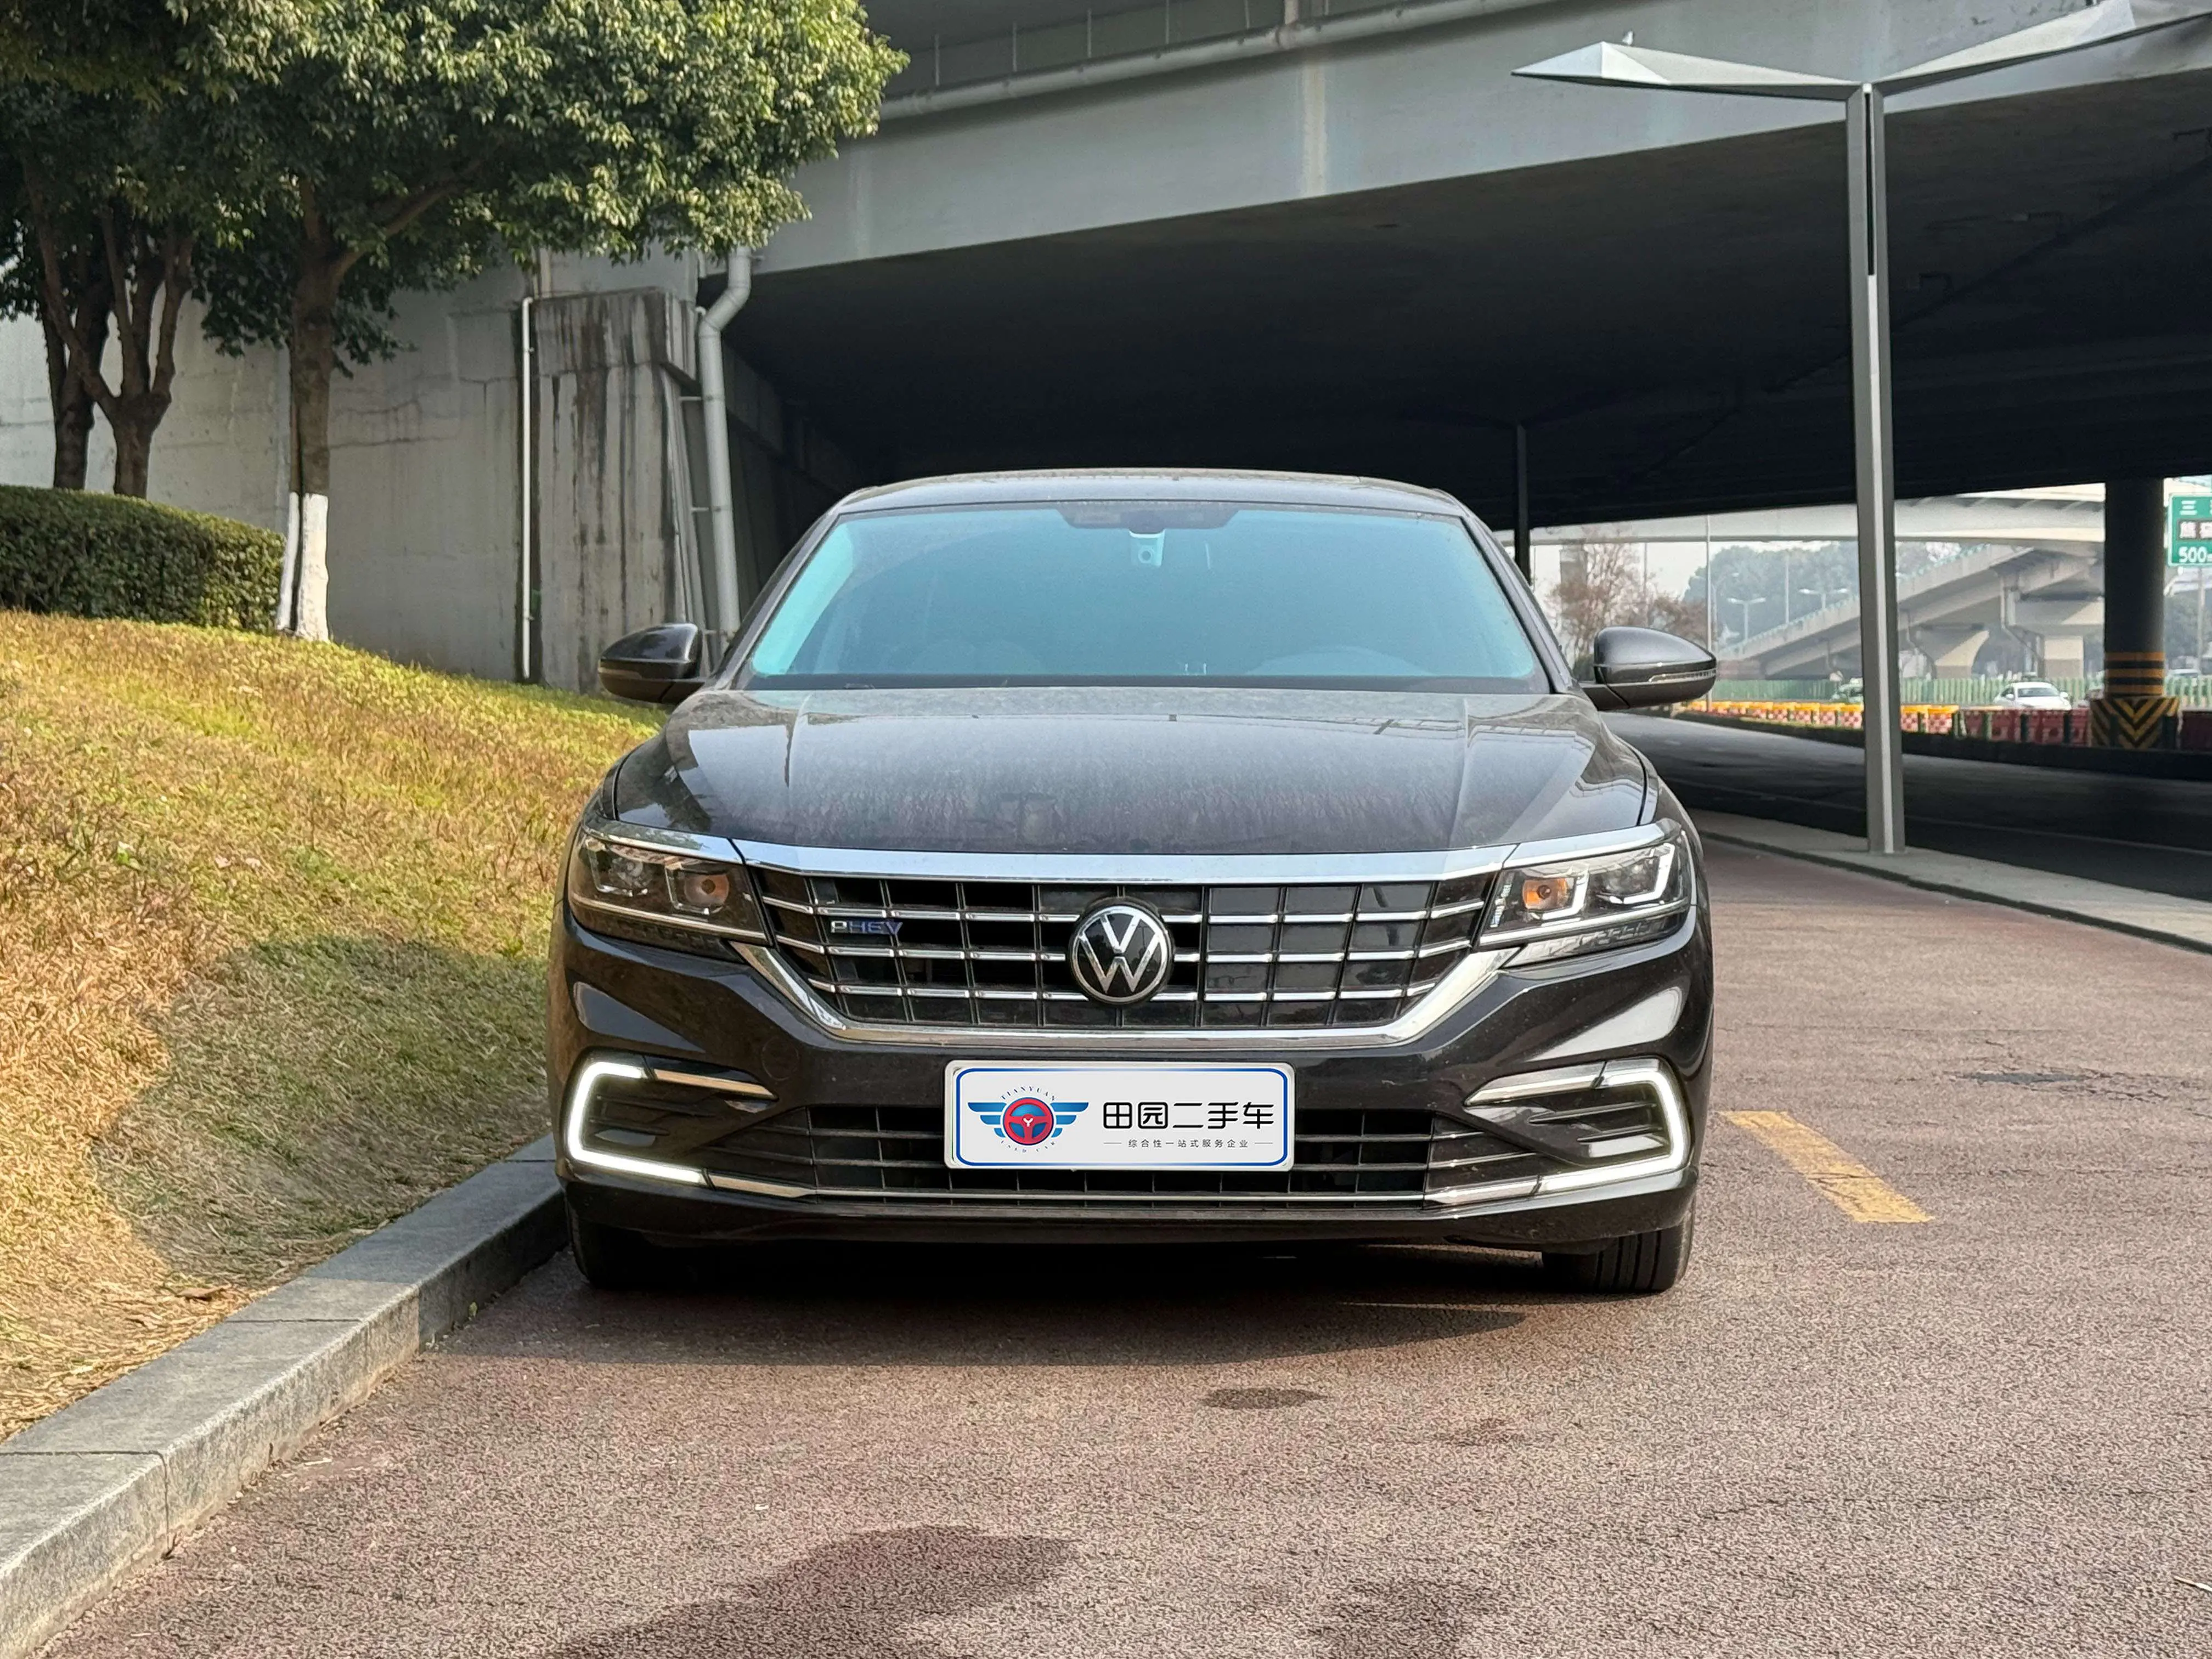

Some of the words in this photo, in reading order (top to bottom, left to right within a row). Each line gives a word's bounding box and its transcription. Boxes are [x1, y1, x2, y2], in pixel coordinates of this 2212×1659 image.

[2180, 500, 2212, 516] 三
[831, 920, 904, 935] PHEV
[1103, 1102, 1274, 1130] 田园二手车
[1128, 1139, 1249, 1148] 综合性一站式服务企业
